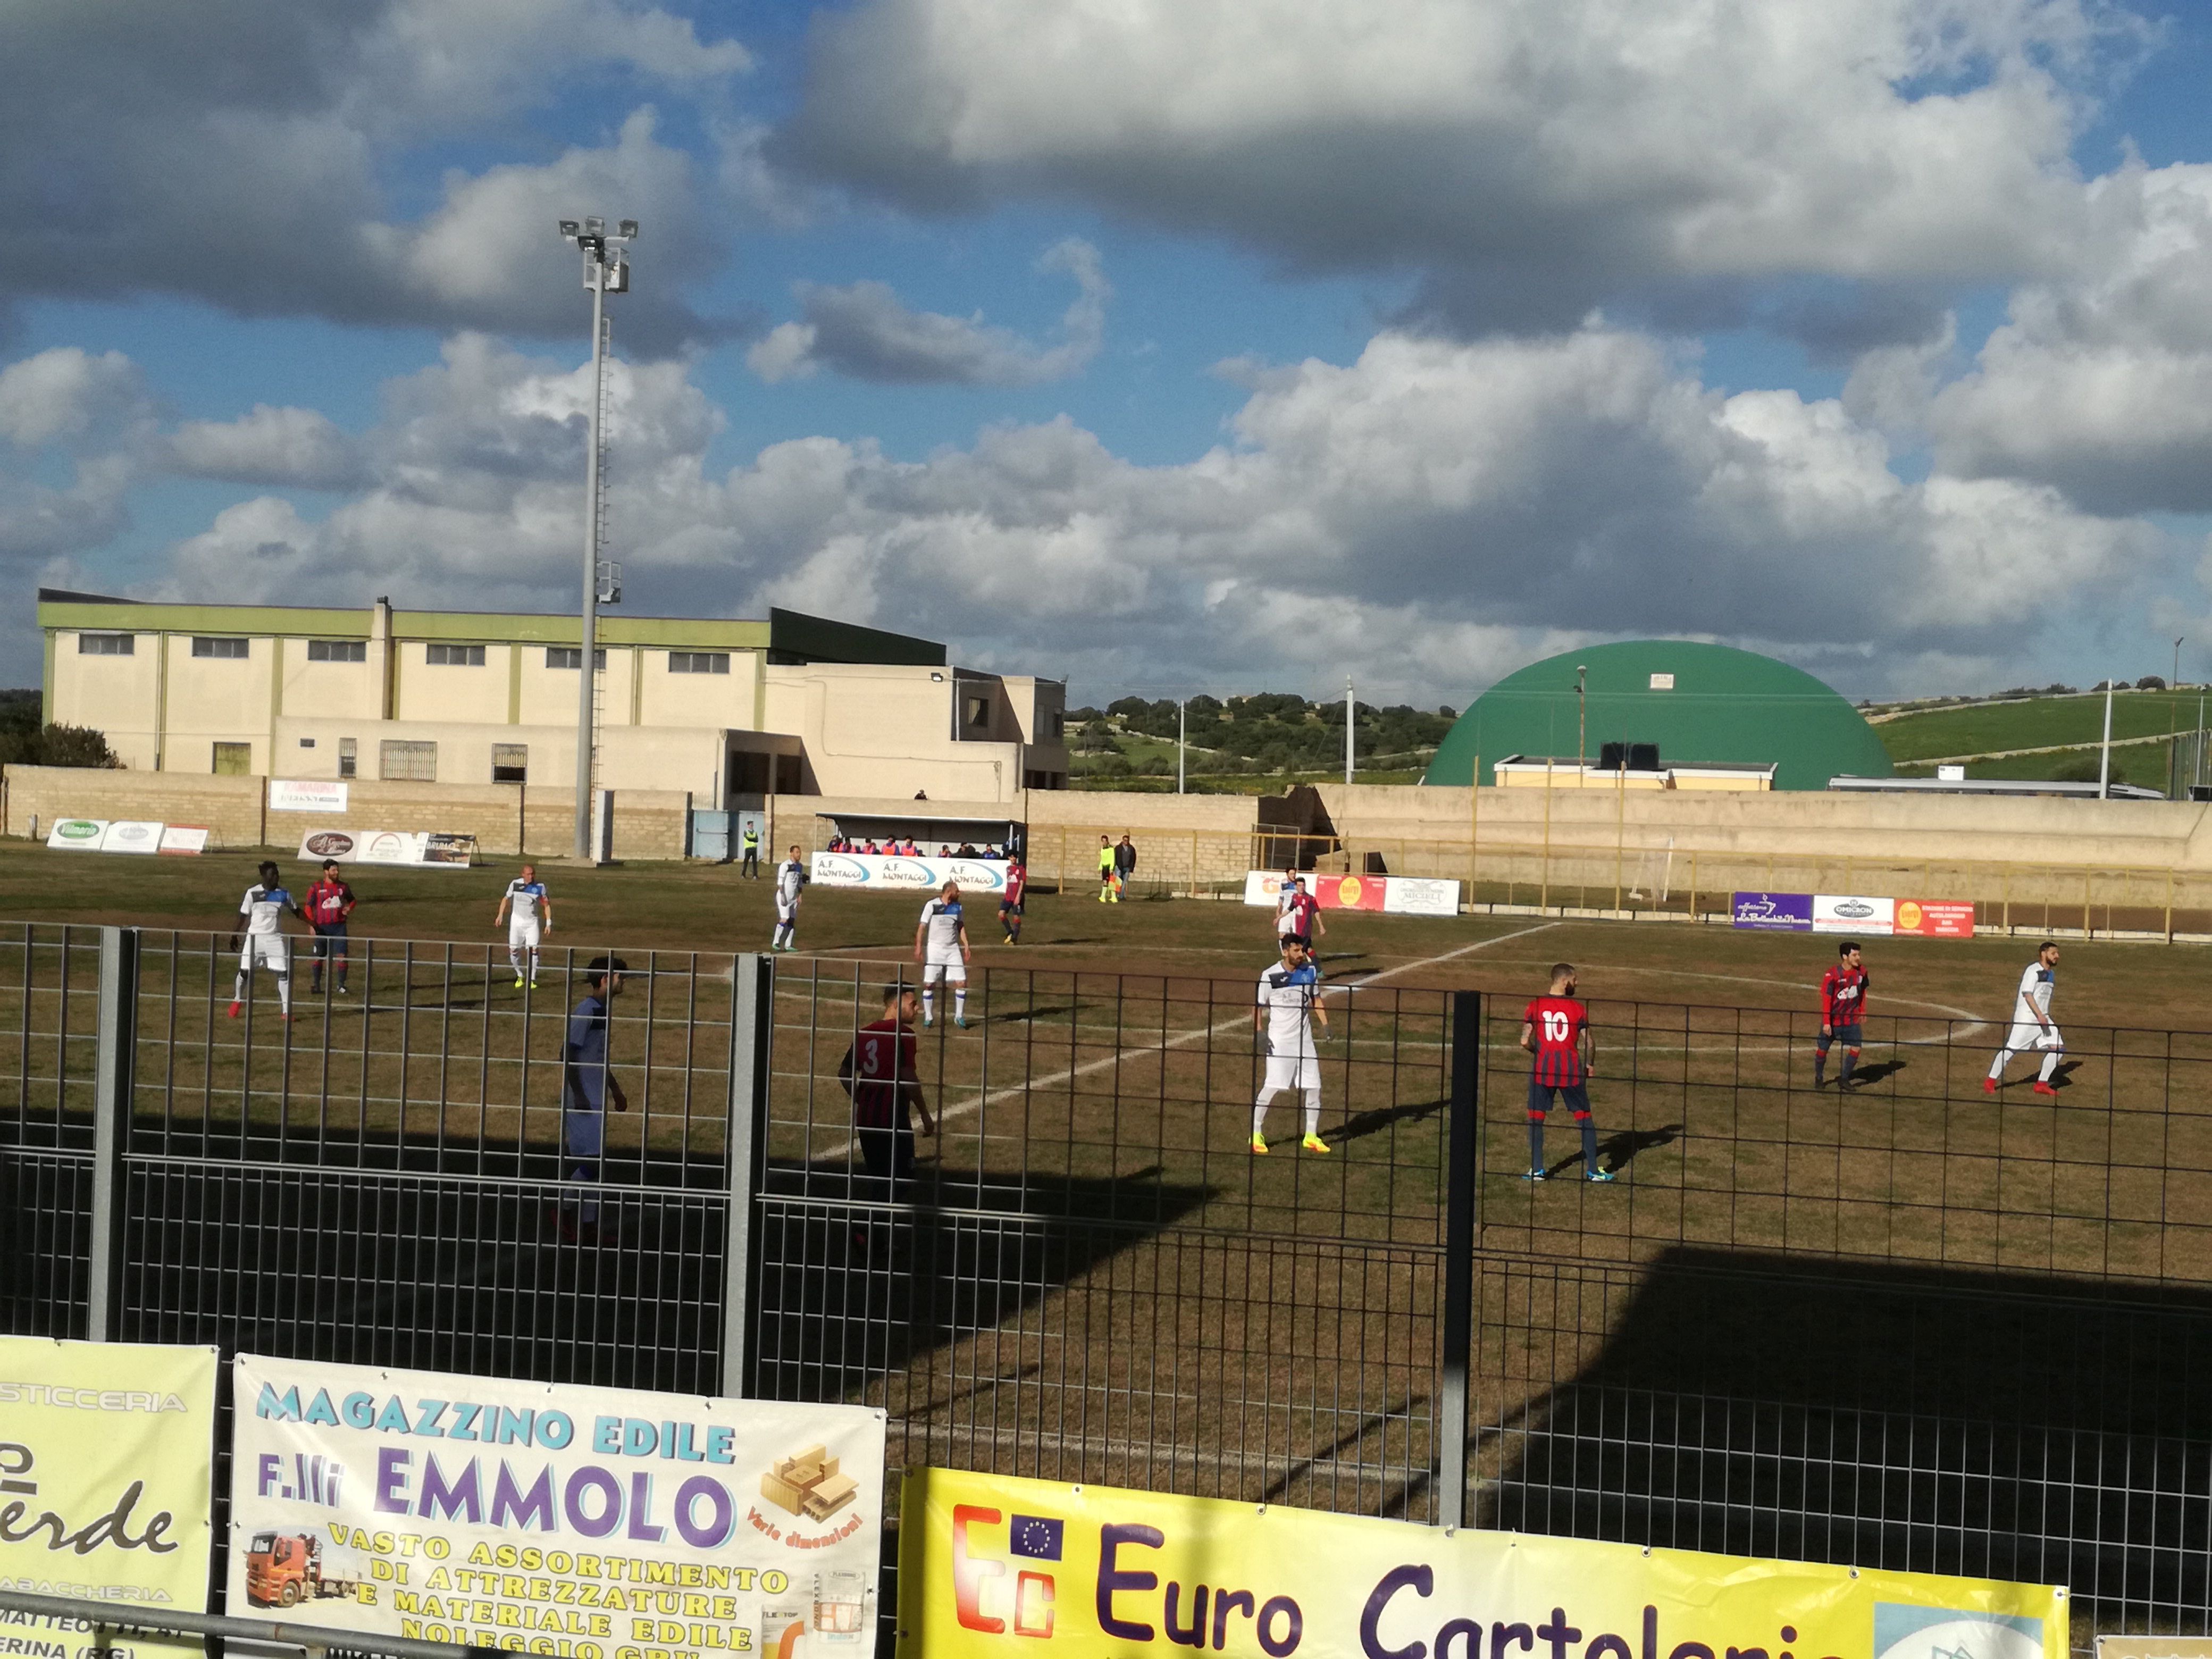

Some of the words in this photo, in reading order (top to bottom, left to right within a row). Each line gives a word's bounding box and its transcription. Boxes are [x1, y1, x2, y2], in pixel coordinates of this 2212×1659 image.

[817, 869, 861, 878] MONTAGGI
[882, 873, 926, 882] MONTAGGI
[1543, 1011, 1569, 1042] 10
[863, 1038, 878, 1074] 3
[0, 1382, 188, 1413] STICCERIA
[256, 1380, 574, 1450] MAGAZZINO
[592, 1415, 735, 1464] EDILE
[373, 1446, 737, 1549] EMMOLO
[747, 1505, 781, 1540] Varie
[785, 1512, 864, 1549] dimensioni
[328, 1522, 451, 1560] VASTO
[468, 1541, 789, 1594] ASSORTIMENTO
[371, 1558, 409, 1585] DI
[426, 1566, 736, 1620] ATTREZZATURE
[1095, 1522, 1304, 1658] Euro
[357, 1582, 378, 1605] E
[394, 1589, 612, 1637] MATERIALE
[631, 1618, 752, 1652] EDILE
[401, 1618, 604, 1658] NOLEGGIO
